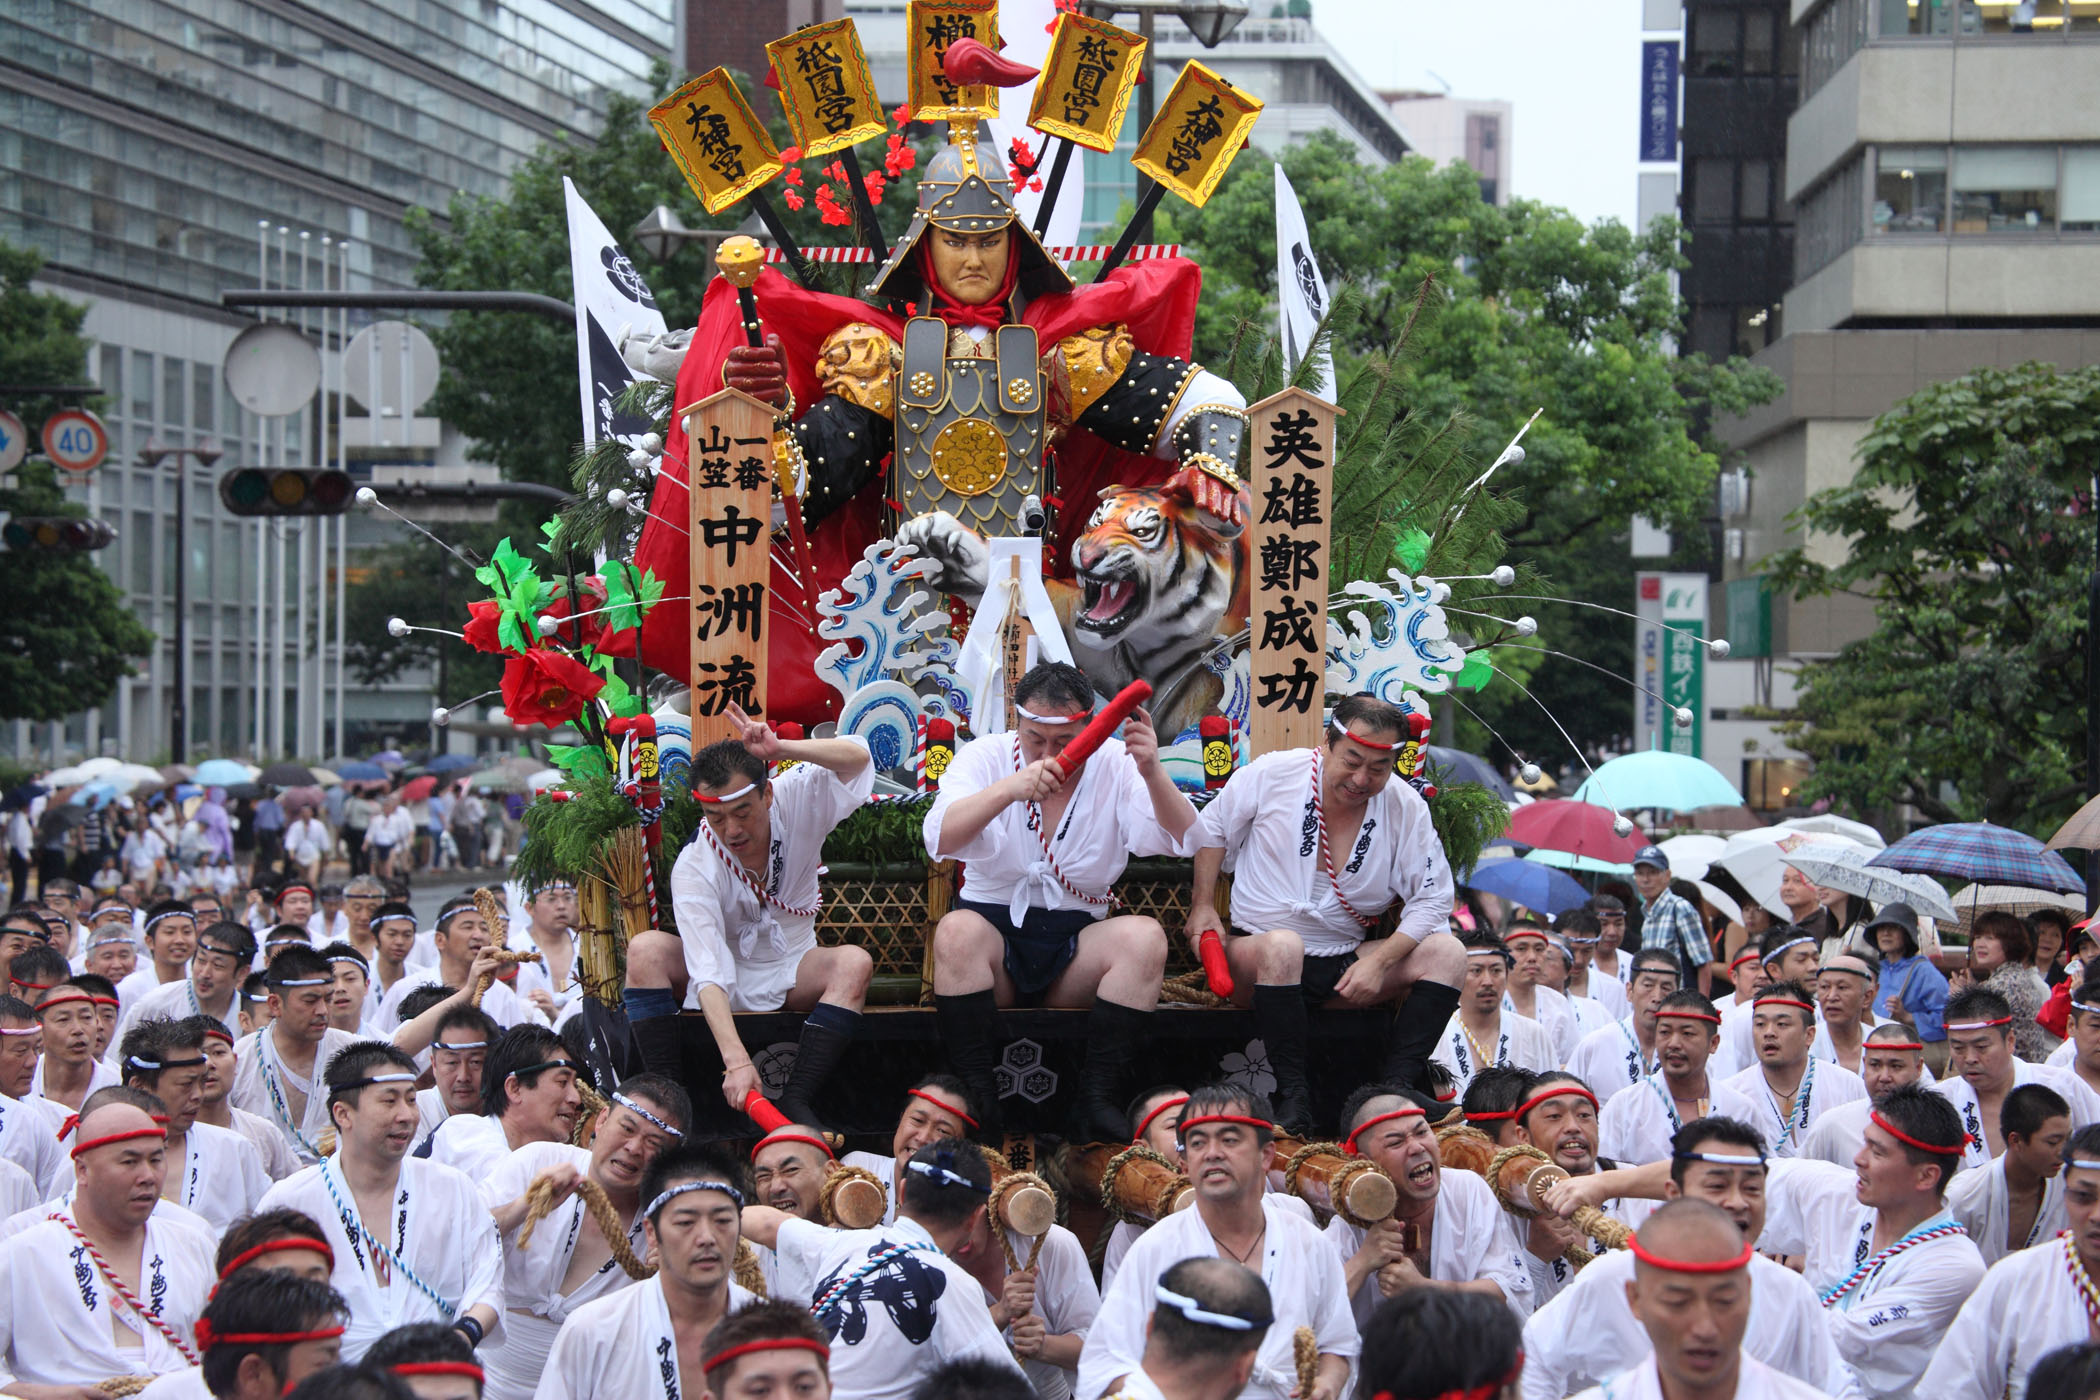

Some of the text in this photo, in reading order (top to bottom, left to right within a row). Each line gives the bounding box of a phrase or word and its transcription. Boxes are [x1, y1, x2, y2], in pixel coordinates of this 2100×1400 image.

[686, 102, 746, 182] 大神宮
[1166, 94, 1224, 176] 大神宮
[58, 426, 92, 453] 40
[697, 425, 732, 490] 山笠
[733, 436, 770, 491] 一番
[1256, 409, 1325, 715] 英雄鄭成功
[695, 504, 766, 717] 中洲流
